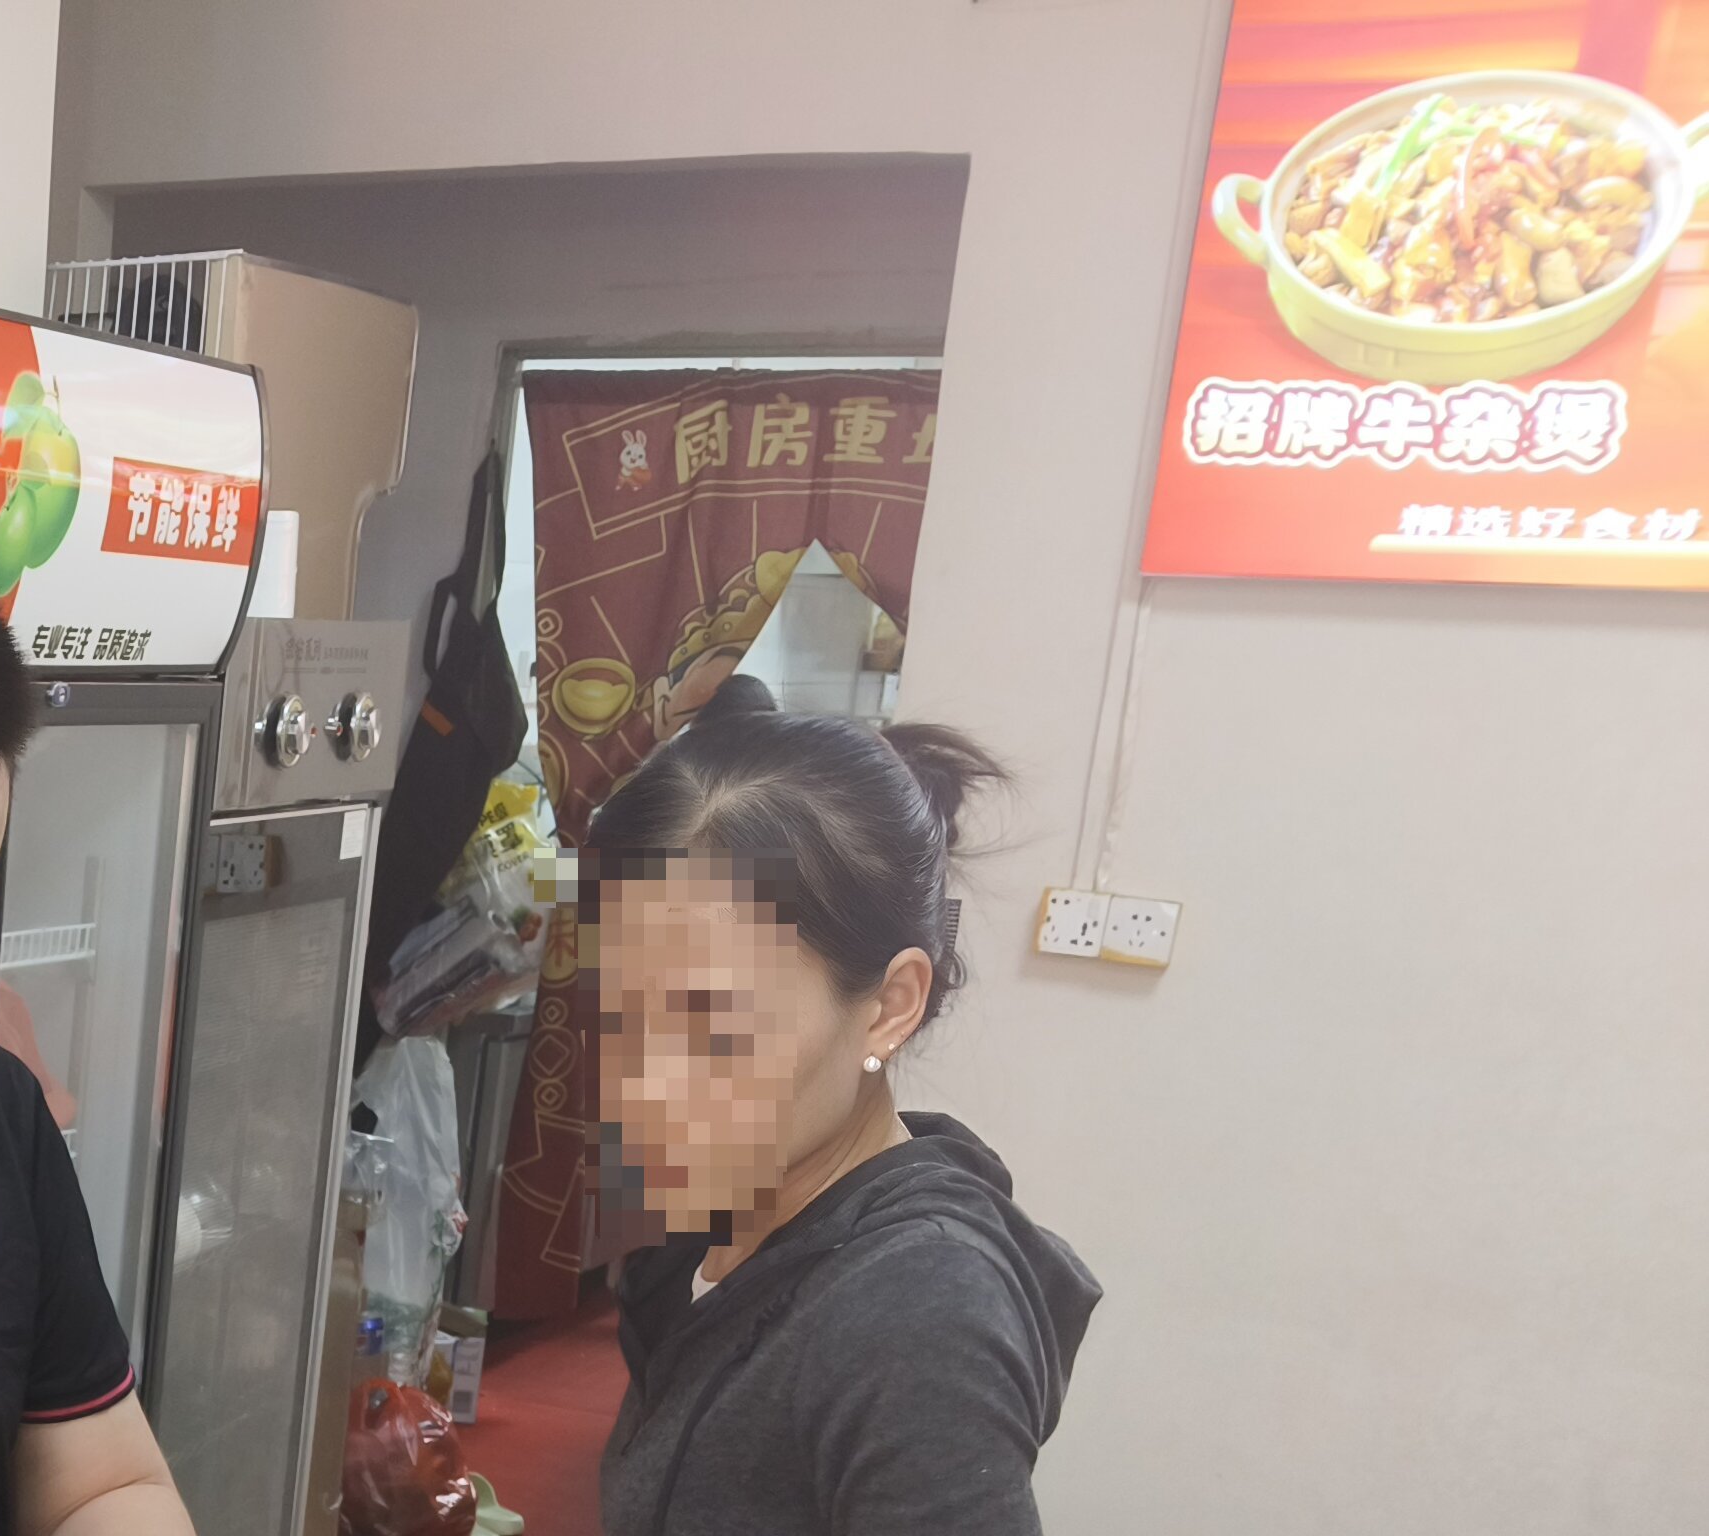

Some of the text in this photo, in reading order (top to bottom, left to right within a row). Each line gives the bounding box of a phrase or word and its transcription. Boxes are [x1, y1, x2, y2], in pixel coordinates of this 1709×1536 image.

[675, 393, 936, 484] 厨房重
[1193, 386, 1616, 462] 招牌牛杂煲
[126, 472, 241, 554] 节能保鲜
[93, 628, 152, 661] 品质追求
